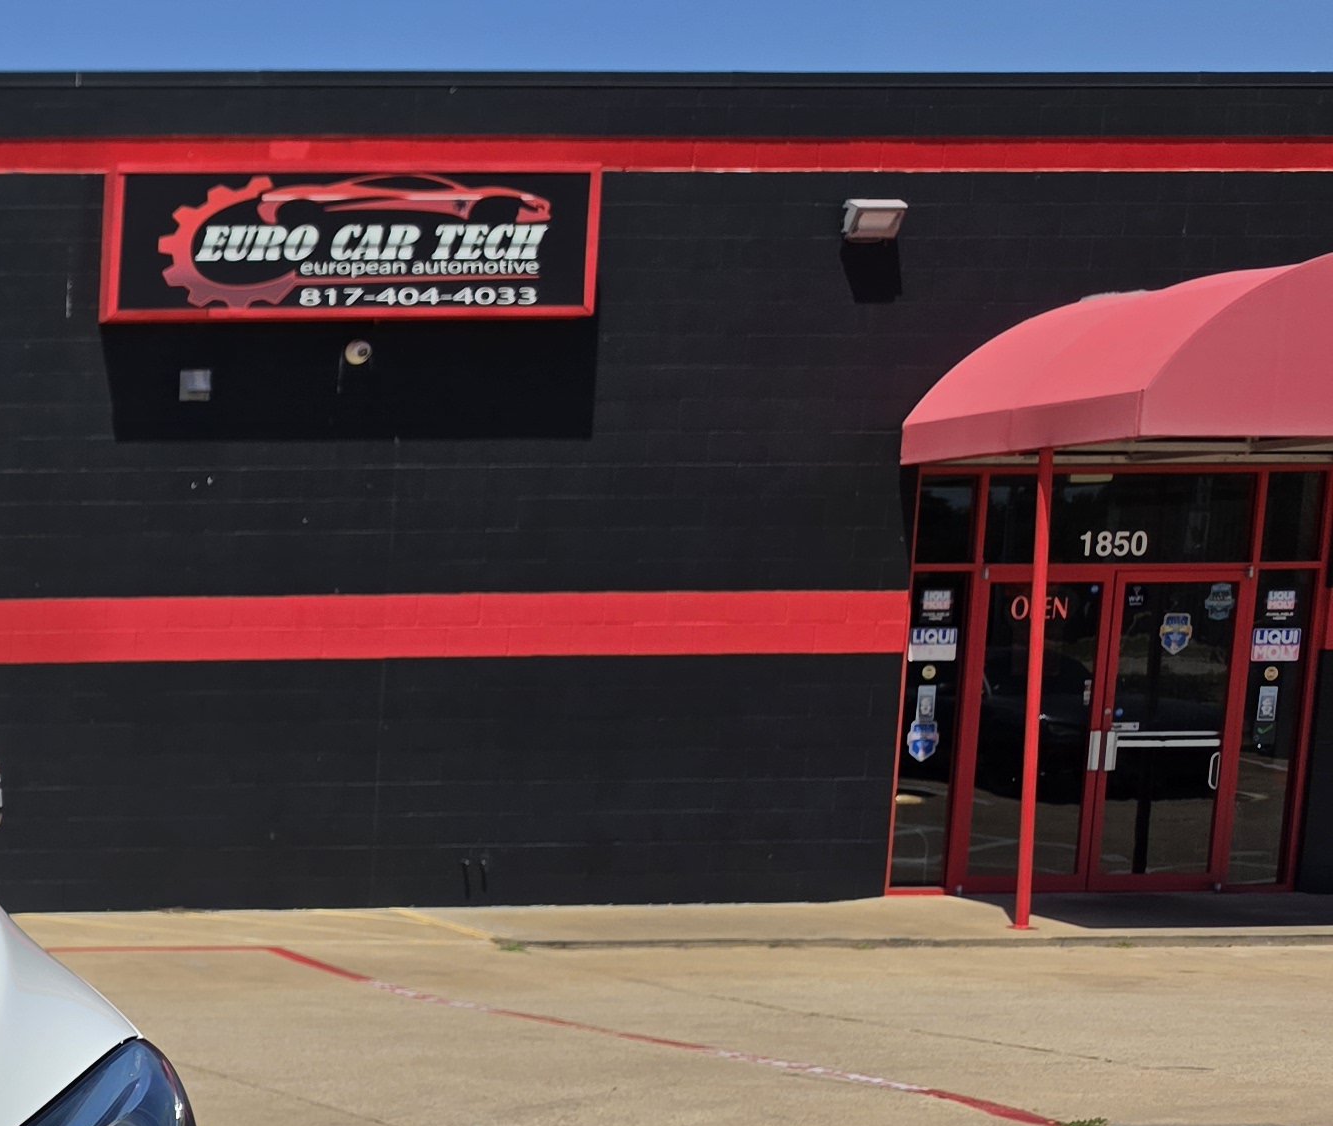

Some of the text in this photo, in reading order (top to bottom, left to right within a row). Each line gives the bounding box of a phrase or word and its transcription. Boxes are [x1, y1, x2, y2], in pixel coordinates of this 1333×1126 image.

[194, 223, 549, 262] EURO CAR TECH
[300, 259, 540, 279] european automotive
[299, 286, 538, 307] 817-404-4033
[1080, 530, 1148, 557] 1850
[1011, 595, 1069, 620] OEN
[912, 628, 956, 645] LIQUI
[1255, 629, 1299, 645] LIQUI
[1253, 645, 1300, 660] MOLY
